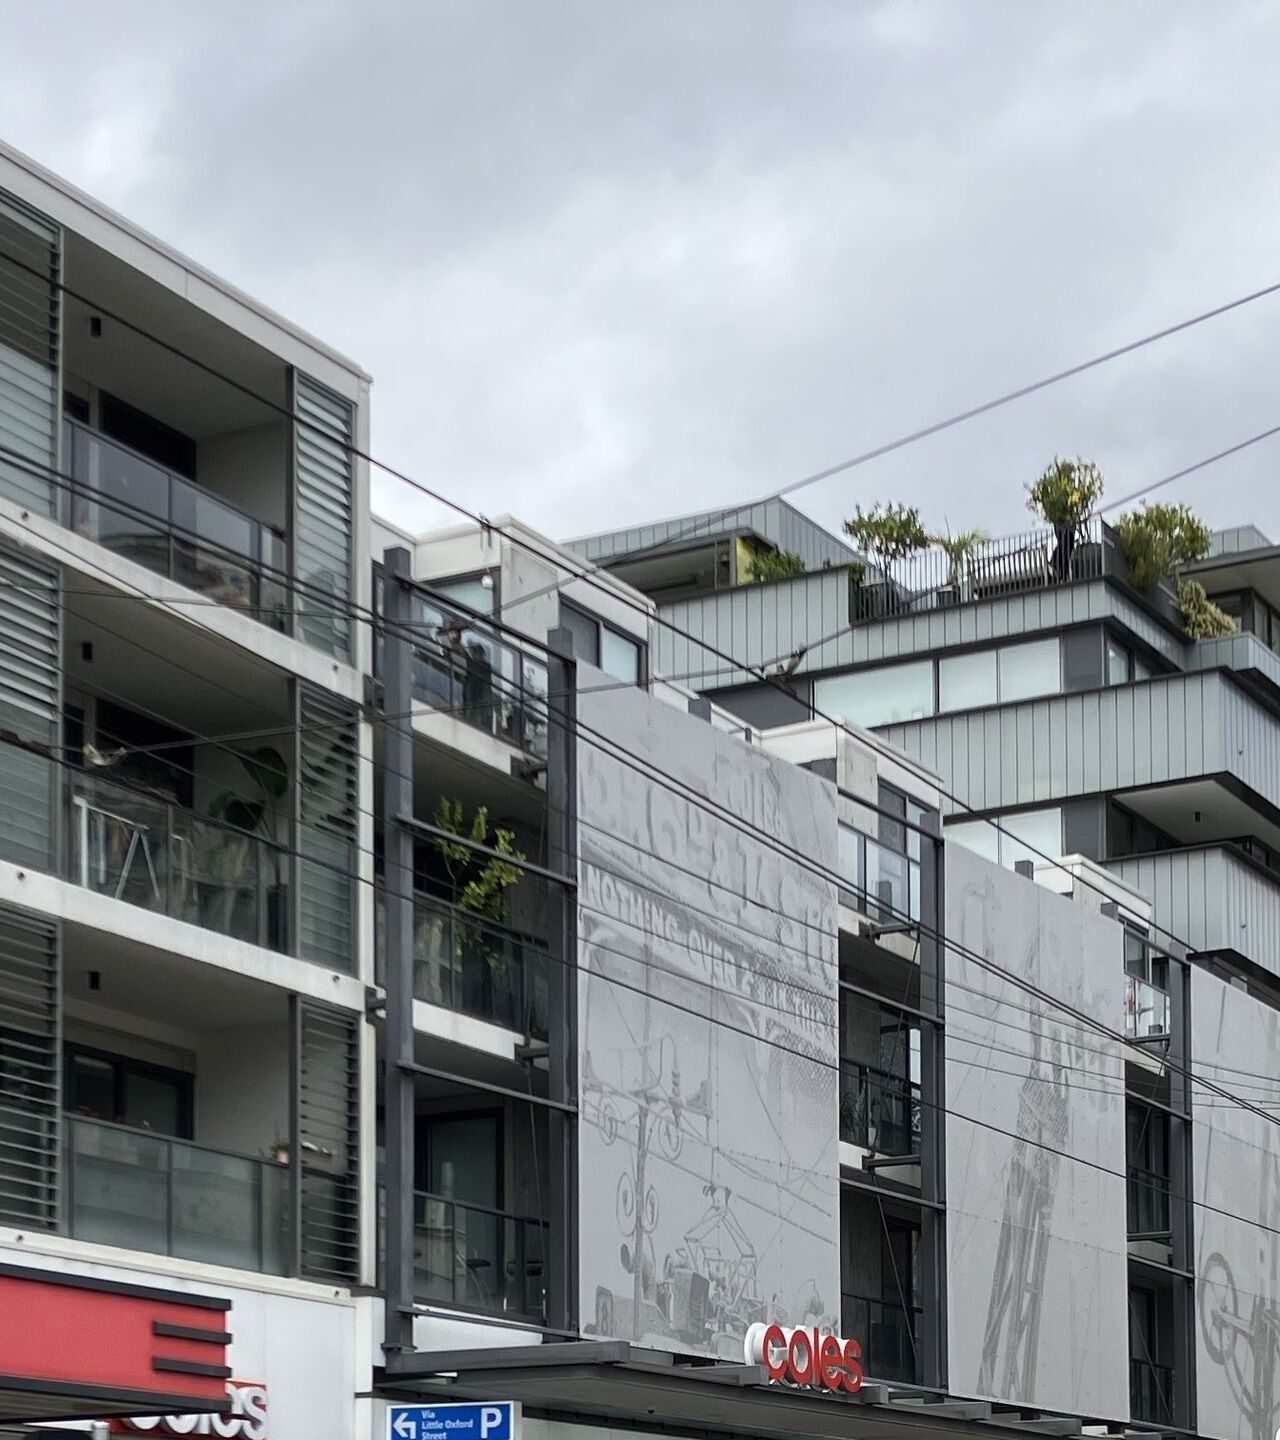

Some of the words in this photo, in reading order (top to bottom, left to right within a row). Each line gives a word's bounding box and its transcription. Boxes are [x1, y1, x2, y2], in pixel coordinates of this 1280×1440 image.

[762, 1323, 864, 1393] coles
[421, 1410, 436, 1419] Via
[421, 1420, 444, 1429] Little
[445, 1418, 474, 1429] Oxford
[480, 1407, 503, 1439] P
[421, 1431, 447, 1440] Street
